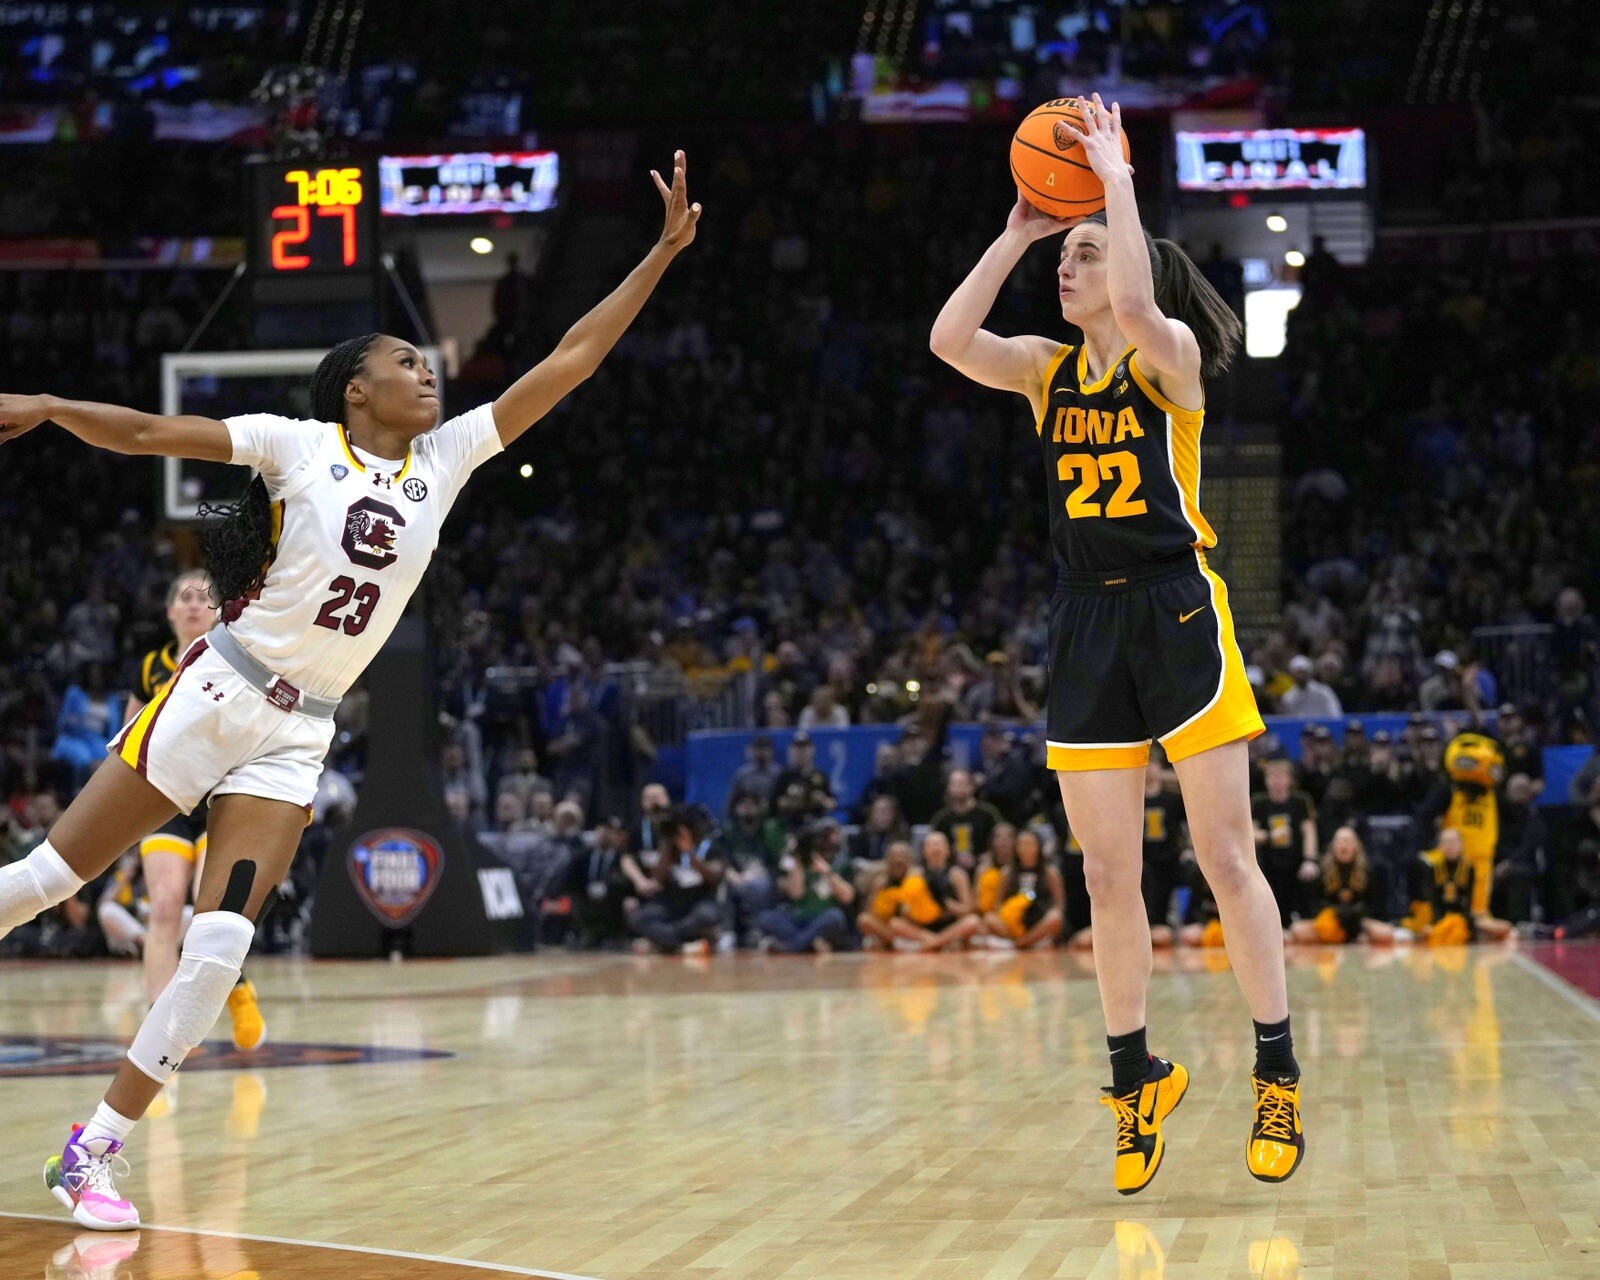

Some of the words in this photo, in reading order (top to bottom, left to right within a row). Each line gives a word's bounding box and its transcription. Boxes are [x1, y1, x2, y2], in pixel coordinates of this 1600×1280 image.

[285, 167, 363, 206] 7:06
[271, 205, 357, 270] 27
[404, 478, 426, 500] SEC
[1057, 450, 1148, 519] 22
[313, 575, 381, 636] 23
[370, 866, 416, 888] FOUR
[371, 849, 416, 867] FINAL
